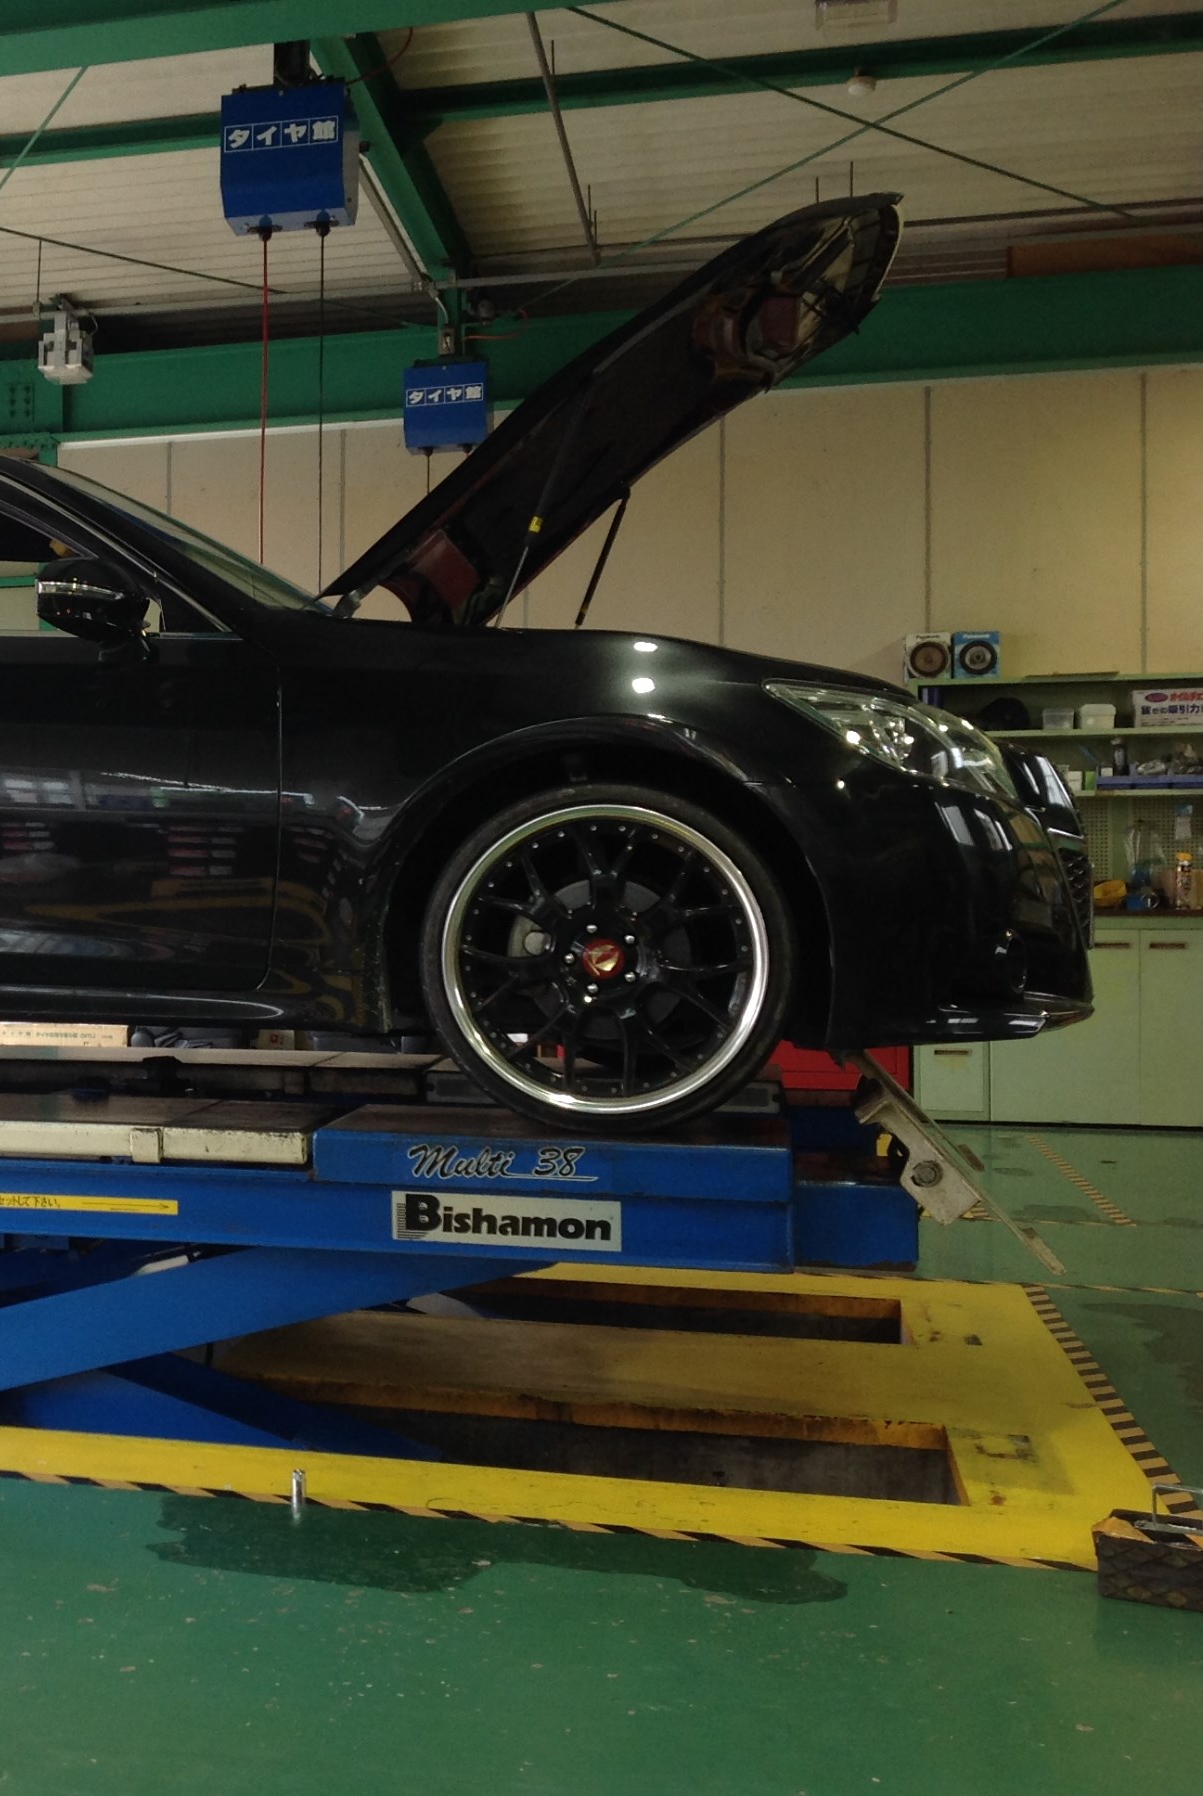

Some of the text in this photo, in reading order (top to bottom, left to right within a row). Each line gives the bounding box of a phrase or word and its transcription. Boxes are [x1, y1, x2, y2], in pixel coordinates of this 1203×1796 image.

[227, 120, 336, 149] タイヤ館
[408, 385, 482, 405] タイヤ館
[408, 1143, 586, 1180] Multi 38
[405, 1193, 612, 1241] Bishamon
